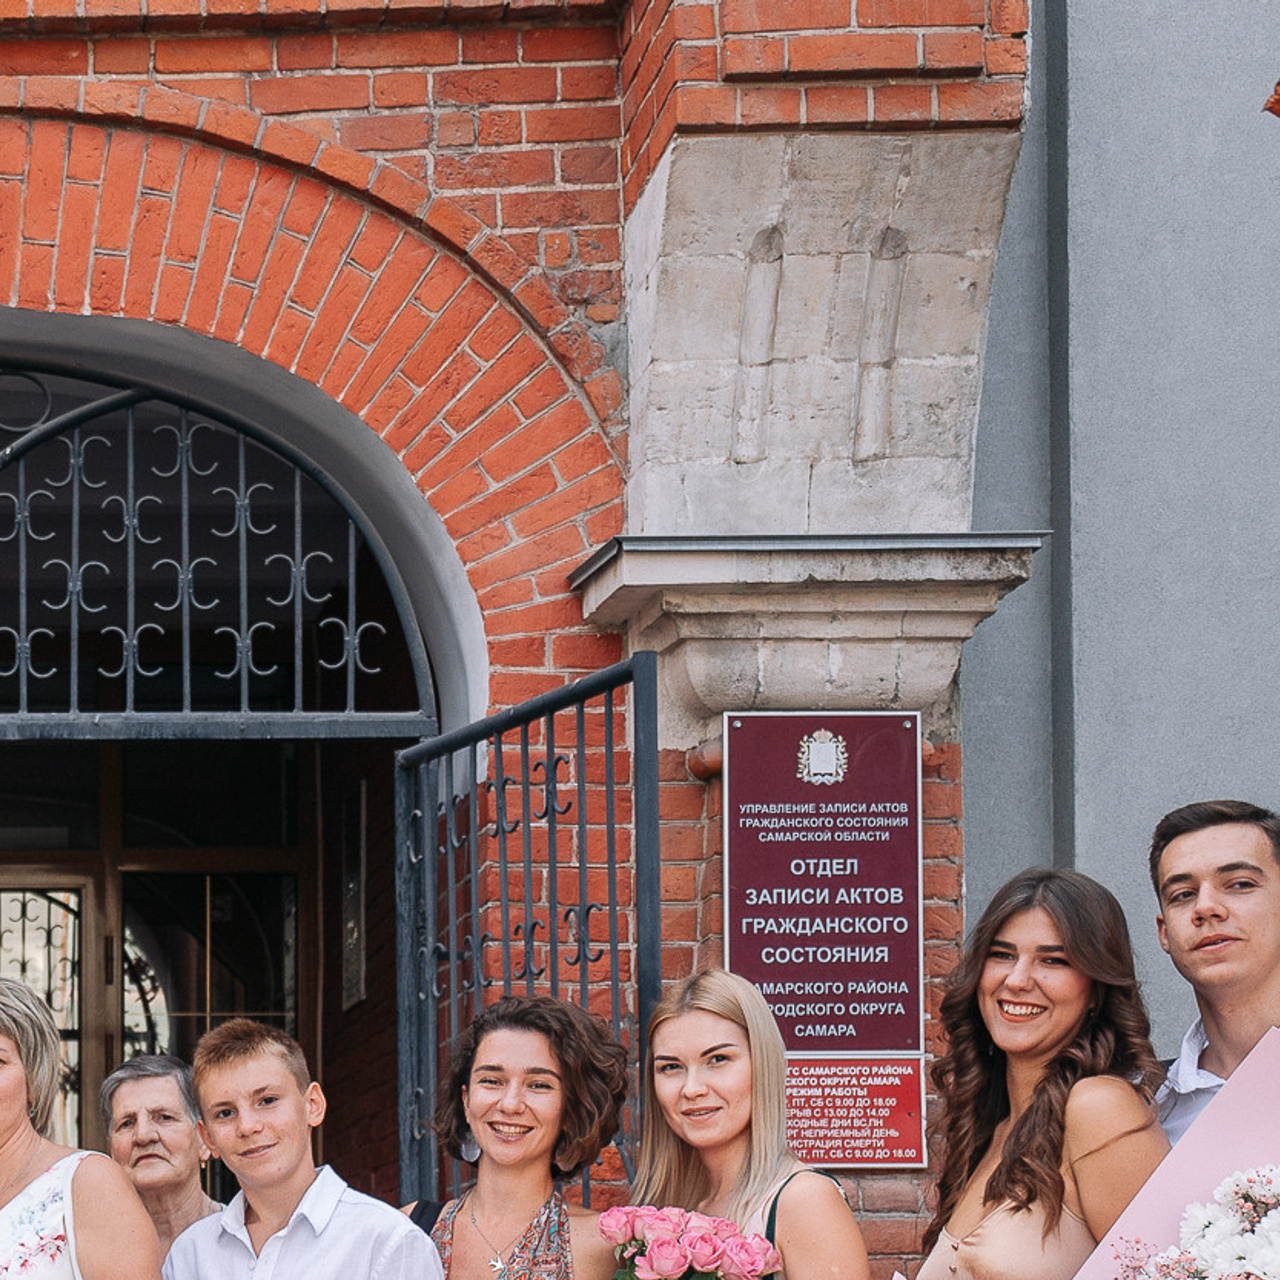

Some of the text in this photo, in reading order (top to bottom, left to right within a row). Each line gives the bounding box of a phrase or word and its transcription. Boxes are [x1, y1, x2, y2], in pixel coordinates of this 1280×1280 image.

[739, 803, 909, 814] УПРАВЛЕНИЕ ЗАПИСИ АКТОВ
[739, 817, 909, 829] ГРАЖДАНСКОГО СОСТОЯНИЯ
[758, 829, 890, 842] САМАРСКОЙ ОБЛАСТИ
[790, 859, 859, 878] ОТДЕЛ
[745, 888, 904, 905] ЗАПИСИ АКТОВ
[742, 917, 909, 936] ГРАЖДАНСКОГО
[761, 946, 889, 964] СОСТОЯНИЯ
[754, 980, 909, 995] АМАРСКОГО РАЙОНА
[769, 1003, 905, 1017] ОДСКОГО ОКРУГА
[795, 1025, 857, 1037] САМАРА
[801, 1066, 870, 1076] САМАРСКОГО
[872, 1065, 913, 1075] РАЙОНА
[784, 1077, 901, 1086] СКОГО ОКРУГА САМАРА
[824, 1087, 867, 1096] РАБОТЫ
[855, 1098, 870, 1108] ДО
[849, 1108, 864, 1118] ДО
[786, 1118, 828, 1128] ХОДНЫЕ
[831, 1118, 851, 1128] ДНИ
[787, 1139, 842, 1149] ИСТРАЦИЯ
[875, 1150, 890, 1159] ДО
